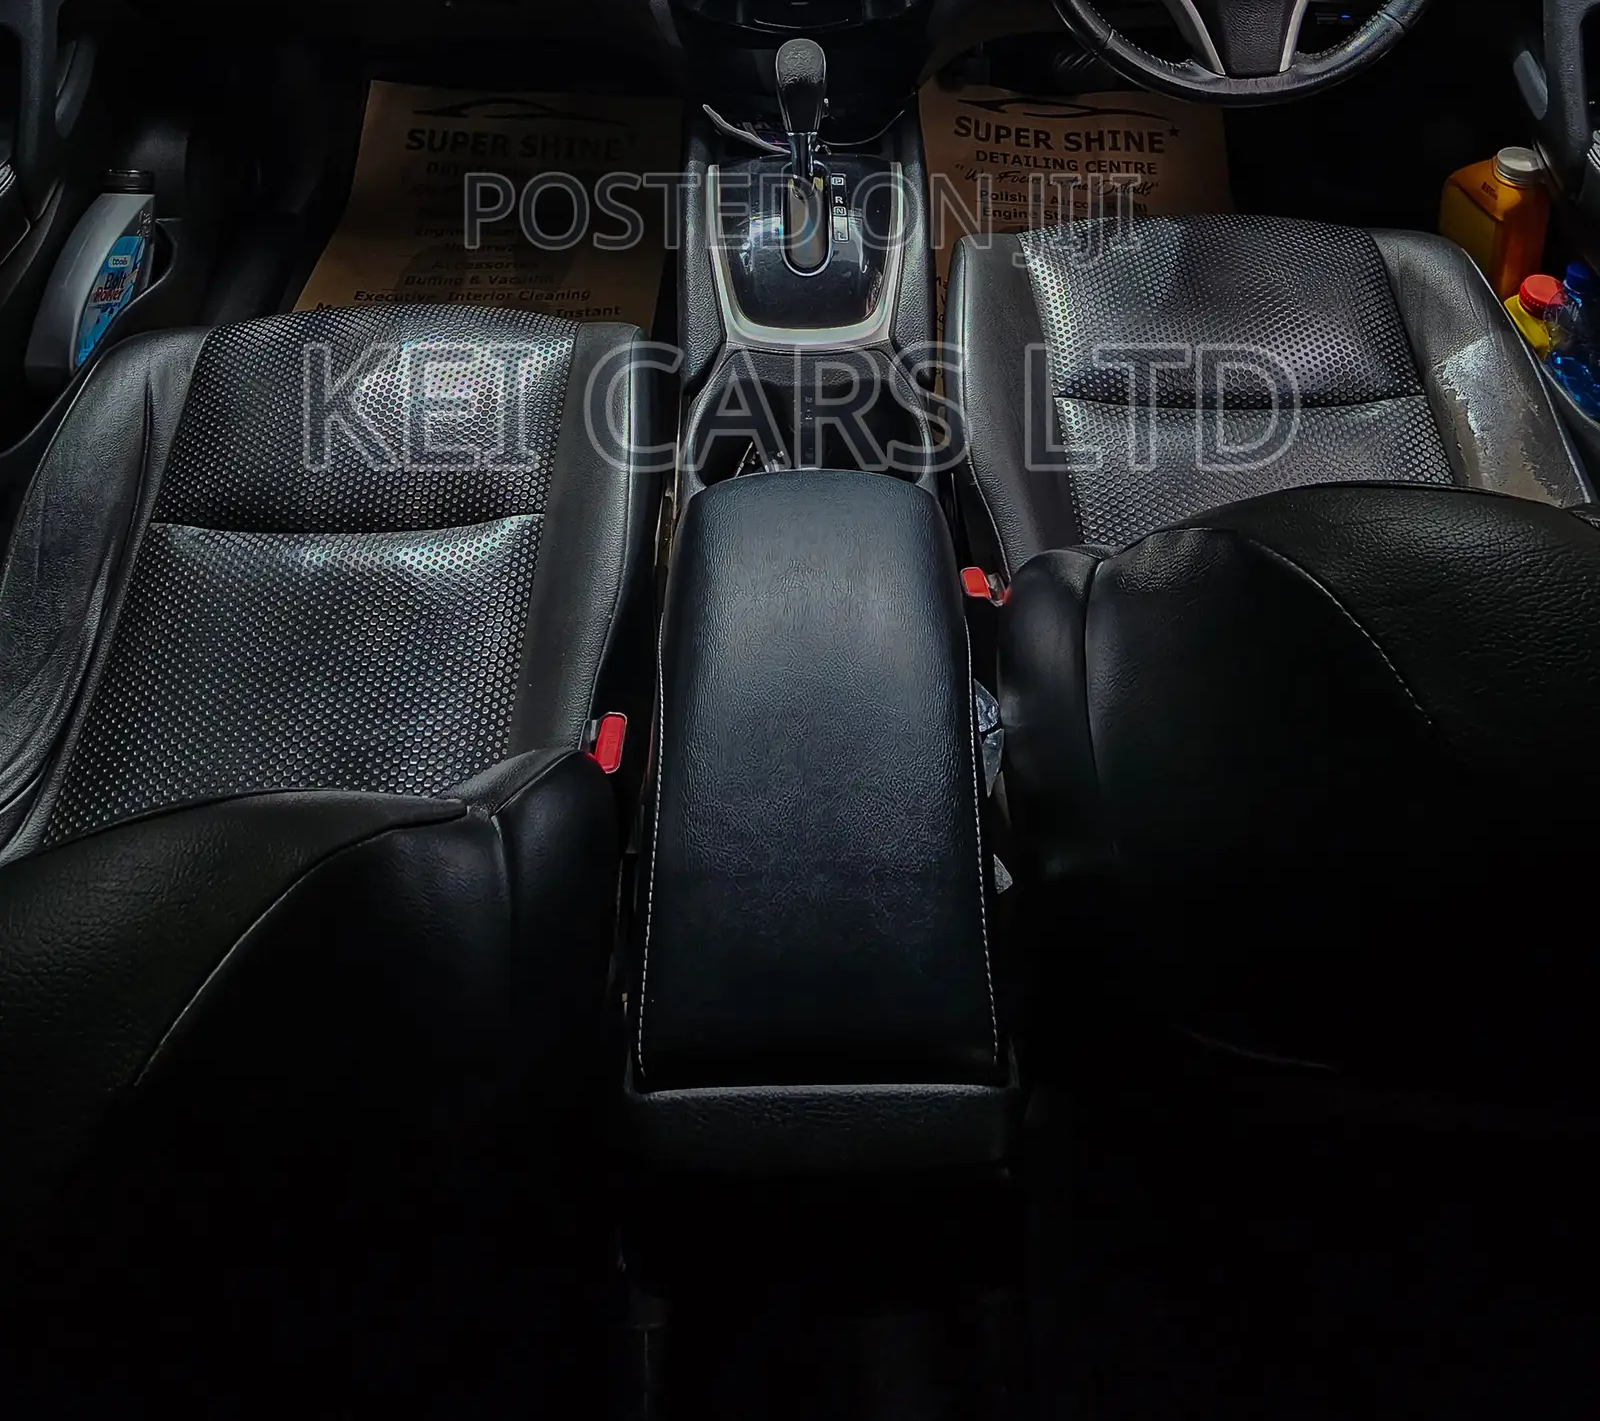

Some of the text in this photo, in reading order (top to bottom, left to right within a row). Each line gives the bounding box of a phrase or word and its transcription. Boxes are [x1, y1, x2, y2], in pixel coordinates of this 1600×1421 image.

[953, 116, 1166, 155] SUPER SHINE
[405, 128, 622, 161] SUPER SHINE
[975, 149, 1158, 176] DETAILING CENTRE
[979, 189, 1027, 204] Polish
[981, 207, 1038, 222] Engine
[446, 290, 513, 302] Interior
[518, 289, 592, 303] Cleaning
[554, 304, 622, 319] Instant
